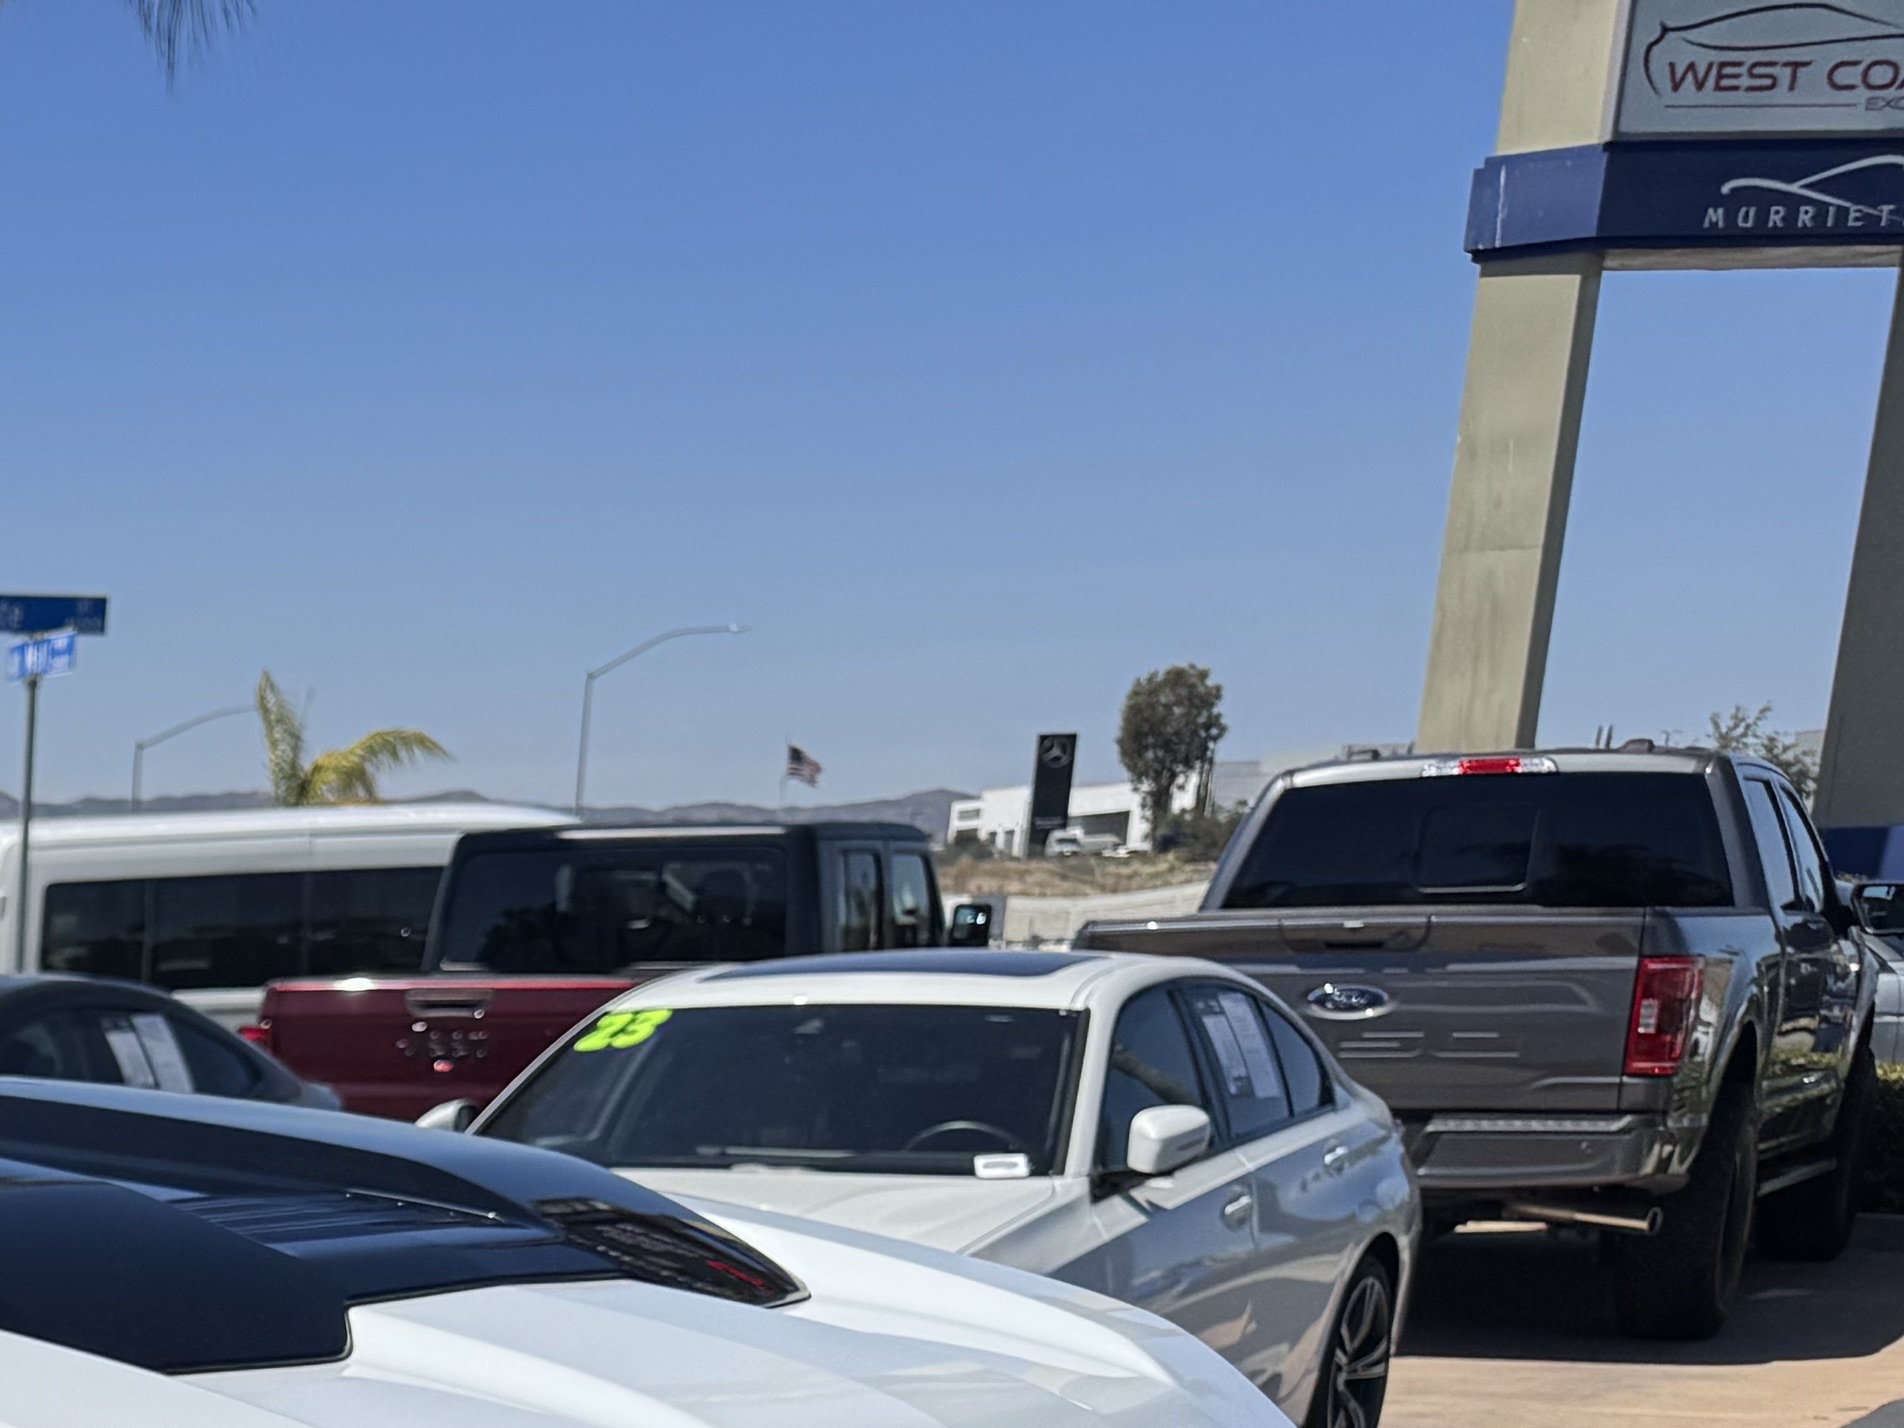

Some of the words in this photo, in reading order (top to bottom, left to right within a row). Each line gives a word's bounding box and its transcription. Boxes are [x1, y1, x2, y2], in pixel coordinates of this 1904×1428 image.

[1668, 60, 1814, 93] WEST
[1826, 60, 1904, 91] CO
[1702, 204, 1904, 228] MURRIET
[573, 1010, 673, 1052] 23
